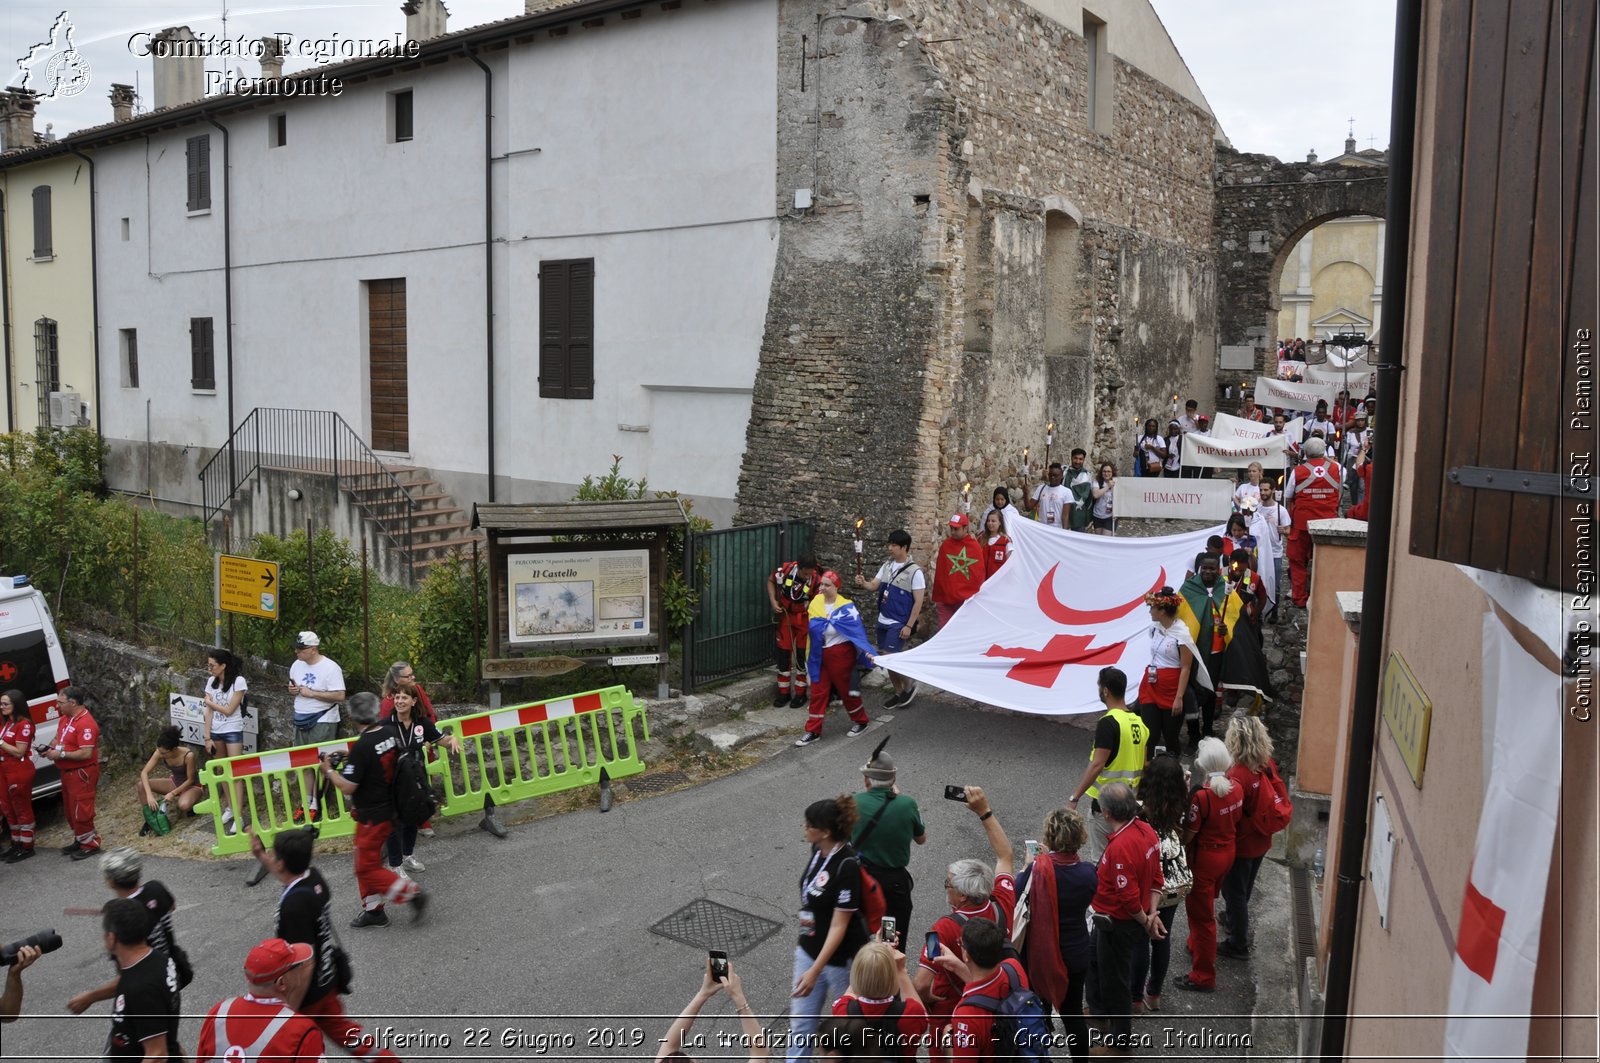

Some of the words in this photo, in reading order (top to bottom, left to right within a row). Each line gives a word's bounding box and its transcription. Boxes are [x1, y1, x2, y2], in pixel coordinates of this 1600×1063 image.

[1268, 388, 1321, 402] INDEPENDENCE
[1197, 446, 1270, 457] IMPARTIALITY
[1143, 492, 1203, 505] HUMANITY
[532, 569, 540, 579] Il
[542, 568, 578, 579] Castello
